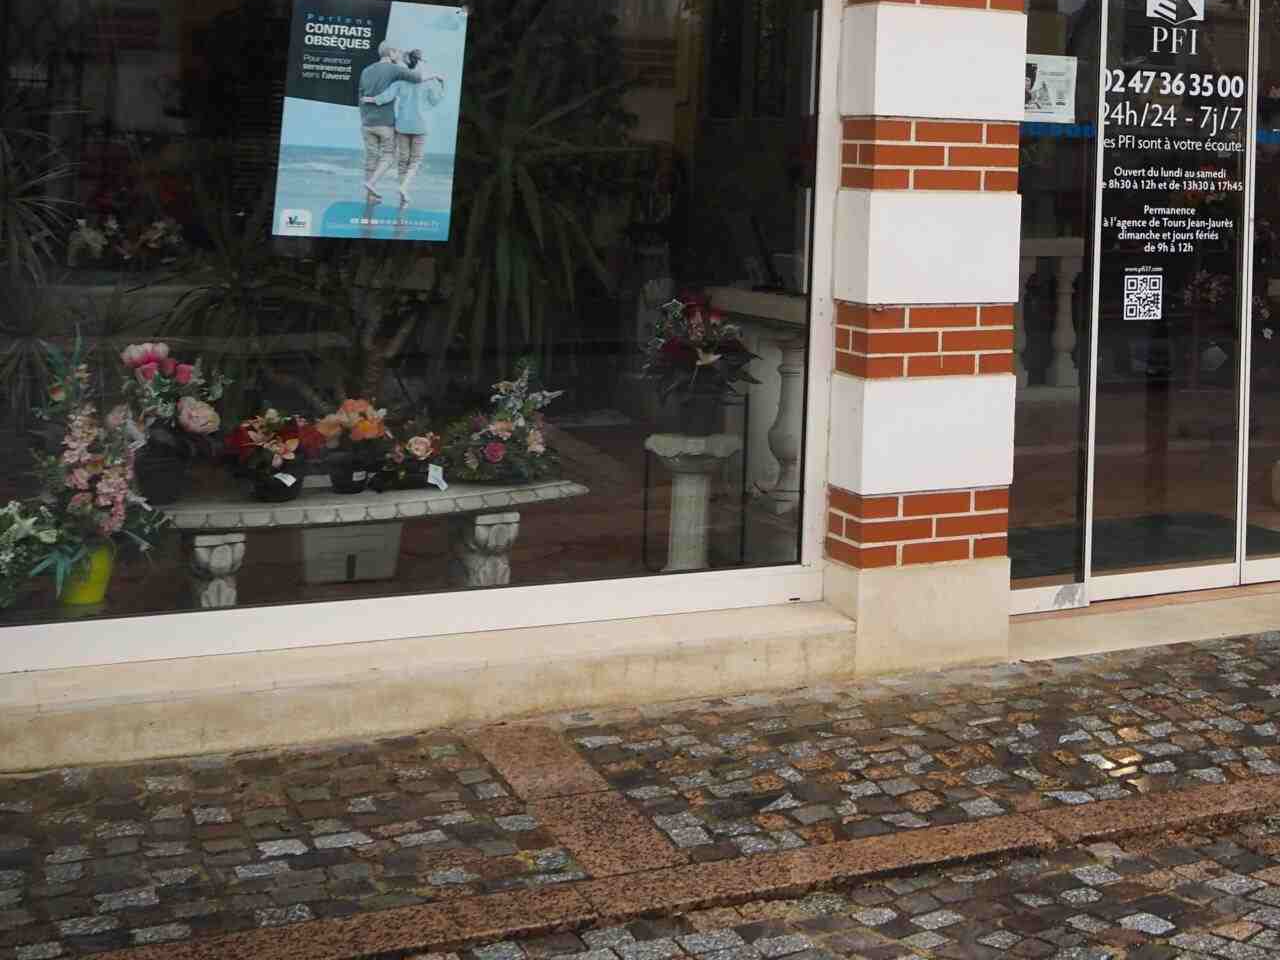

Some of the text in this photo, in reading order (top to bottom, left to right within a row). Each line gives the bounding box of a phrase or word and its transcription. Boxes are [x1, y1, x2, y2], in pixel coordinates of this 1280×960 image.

[305, 22, 372, 38] CONTRATS
[1151, 25, 1200, 55] PFI
[1128, 70, 1156, 94] 47
[1160, 71, 1186, 95] 36
[1189, 73, 1213, 97] 35
[1217, 74, 1244, 98] 00
[1200, 106, 1242, 137] 7j/7
[1103, 135, 1244, 152] es PFI sont à votre écoute.
[1113, 166, 1226, 179] Ouvert du lundi au samedi
[1108, 179, 1130, 189] 8h30
[1132, 179, 1138, 189] à
[1141, 180, 1156, 190] 12h
[1158, 181, 1167, 190] et
[1169, 180, 1180, 190] de
[1183, 181, 1208, 191] 13h30
[1218, 181, 1243, 191] 17h45
[1143, 205, 1196, 215] Permanence
[1103, 217, 1233, 230] à l'agence de Tours Jean-Jaurès
[1118, 230, 1219, 242] dimanche et jours fériés
[1144, 242, 1156, 252] de
[1157, 243, 1168, 253] 9h
[1178, 243, 1193, 253] 12h
